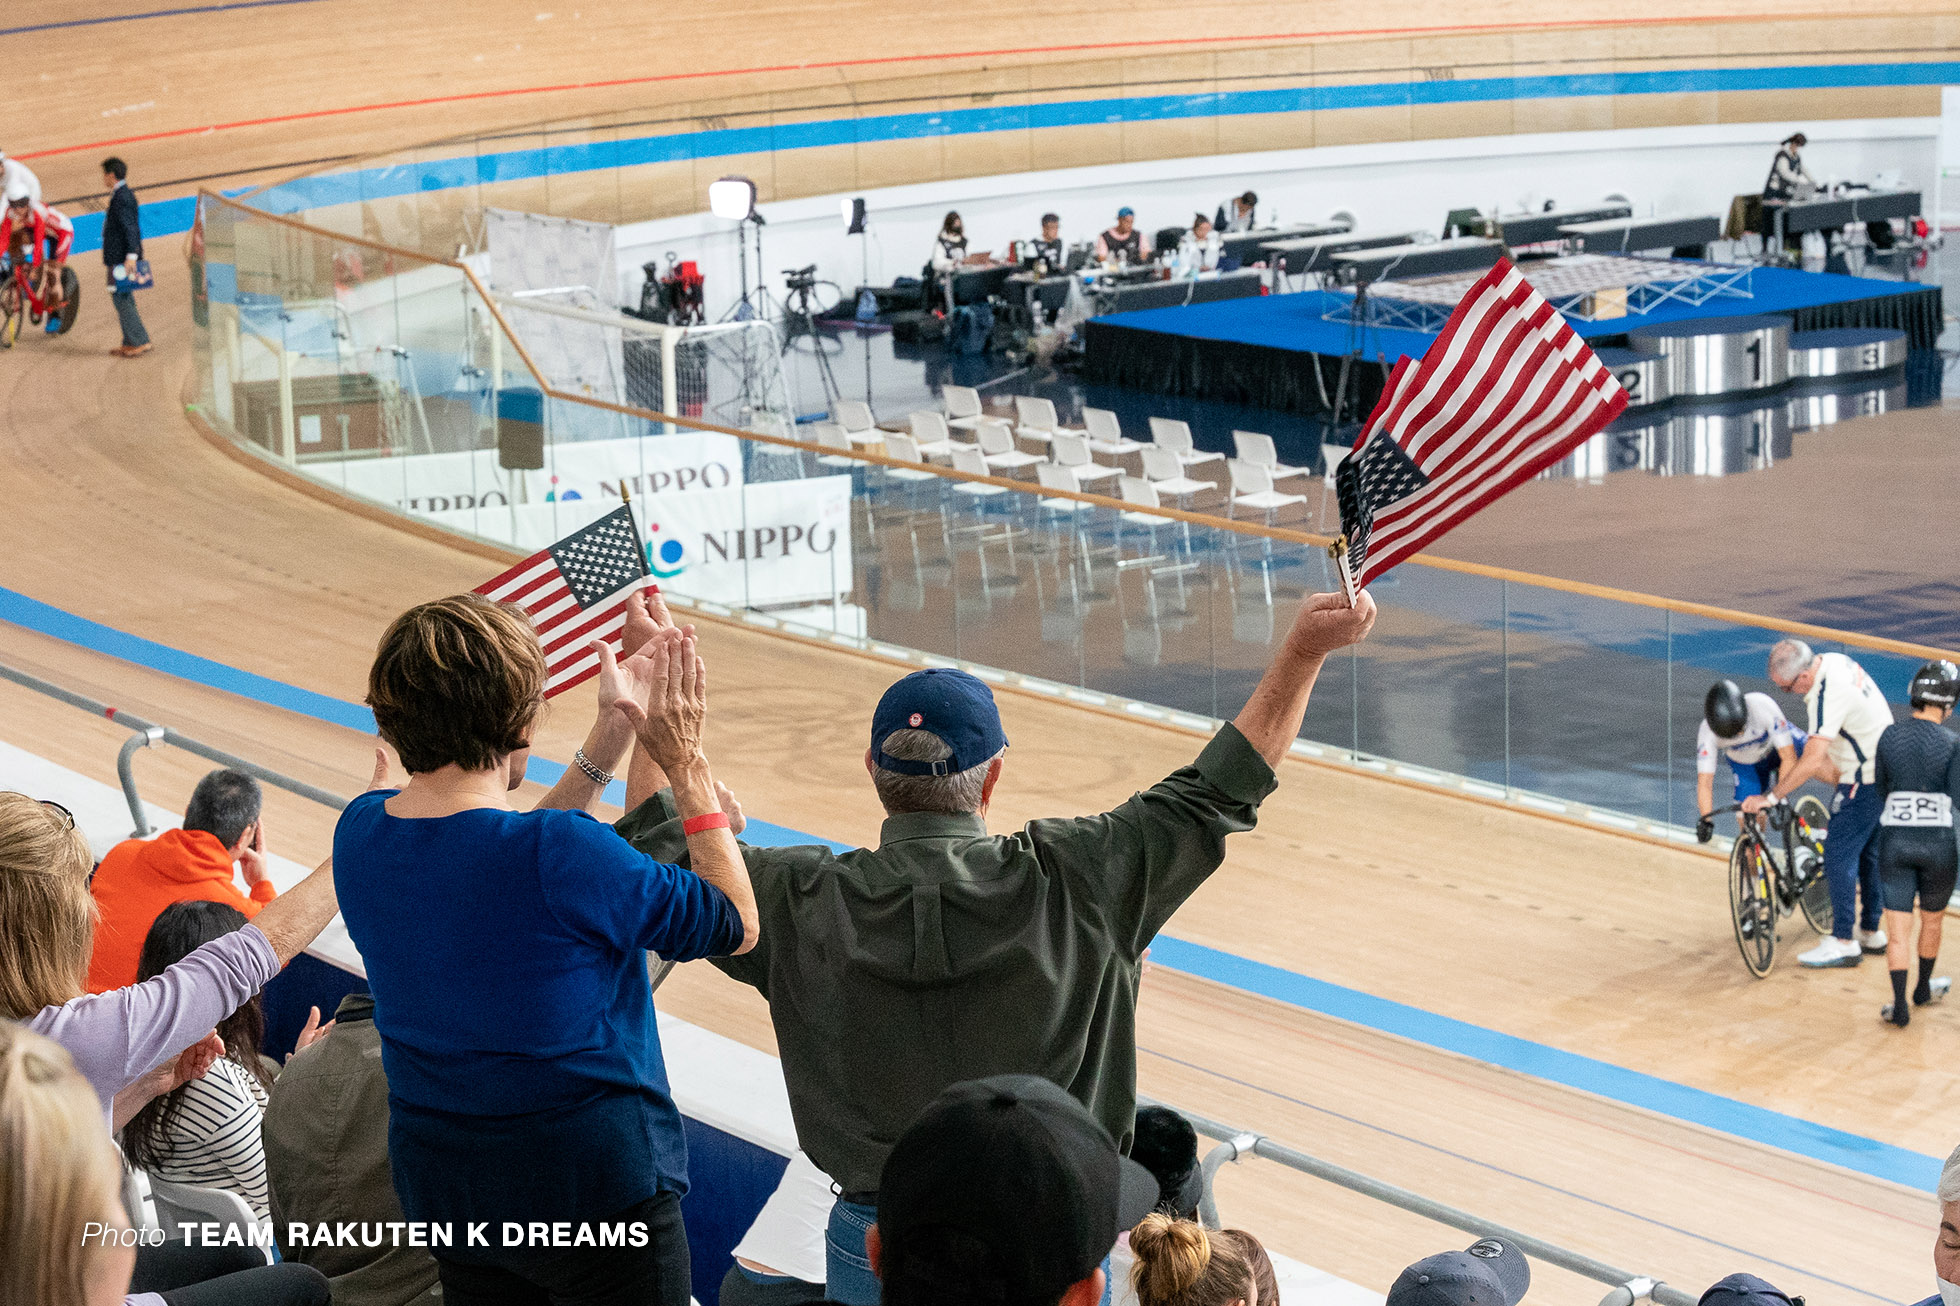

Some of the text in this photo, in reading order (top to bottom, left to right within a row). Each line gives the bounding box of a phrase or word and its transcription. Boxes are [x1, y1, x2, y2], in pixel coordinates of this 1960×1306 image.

[1746, 338, 1760, 381] 1
[1863, 348, 1878, 366] 3
[1618, 369, 1641, 399] 2
[702, 521, 836, 564] NIPPO
